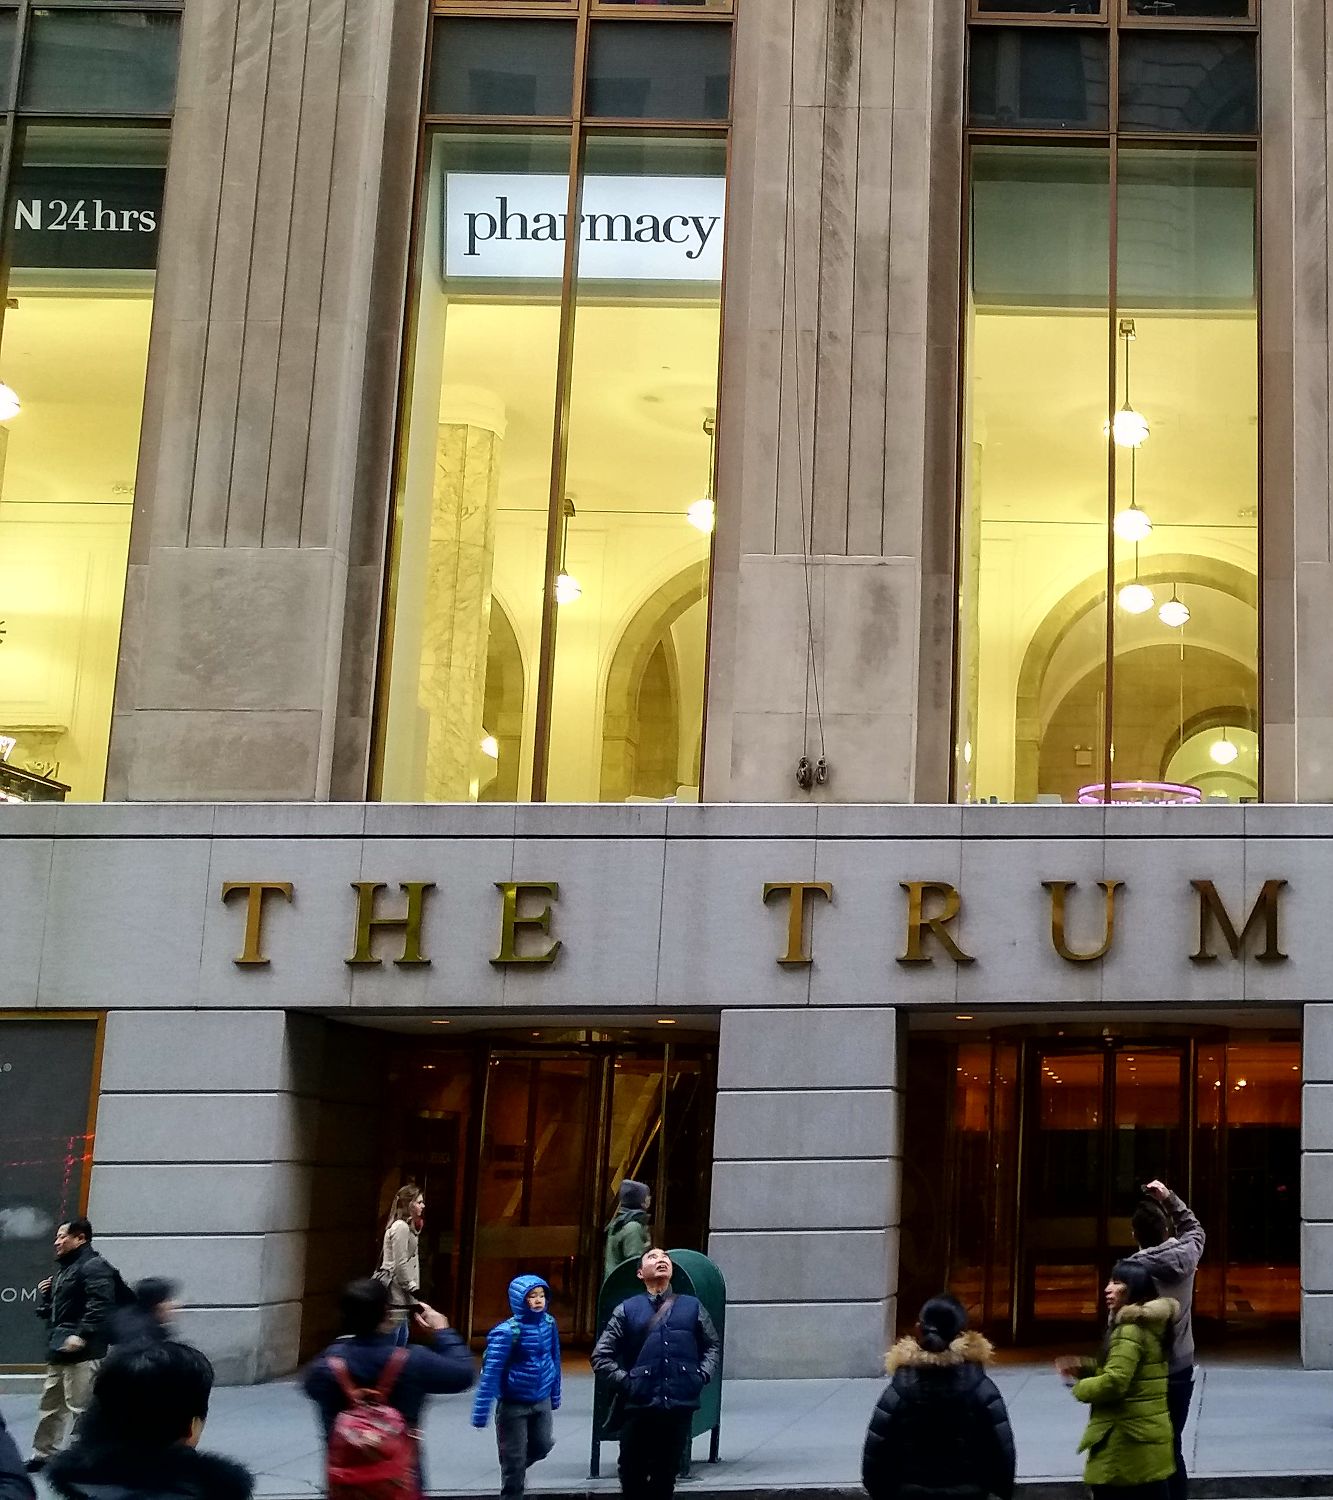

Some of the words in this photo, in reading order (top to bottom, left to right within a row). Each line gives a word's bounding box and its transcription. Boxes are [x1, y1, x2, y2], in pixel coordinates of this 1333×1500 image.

[463, 196, 721, 260] pharmacy
[222, 881, 564, 965] THE
[1, 1287, 37, 1302] OM
